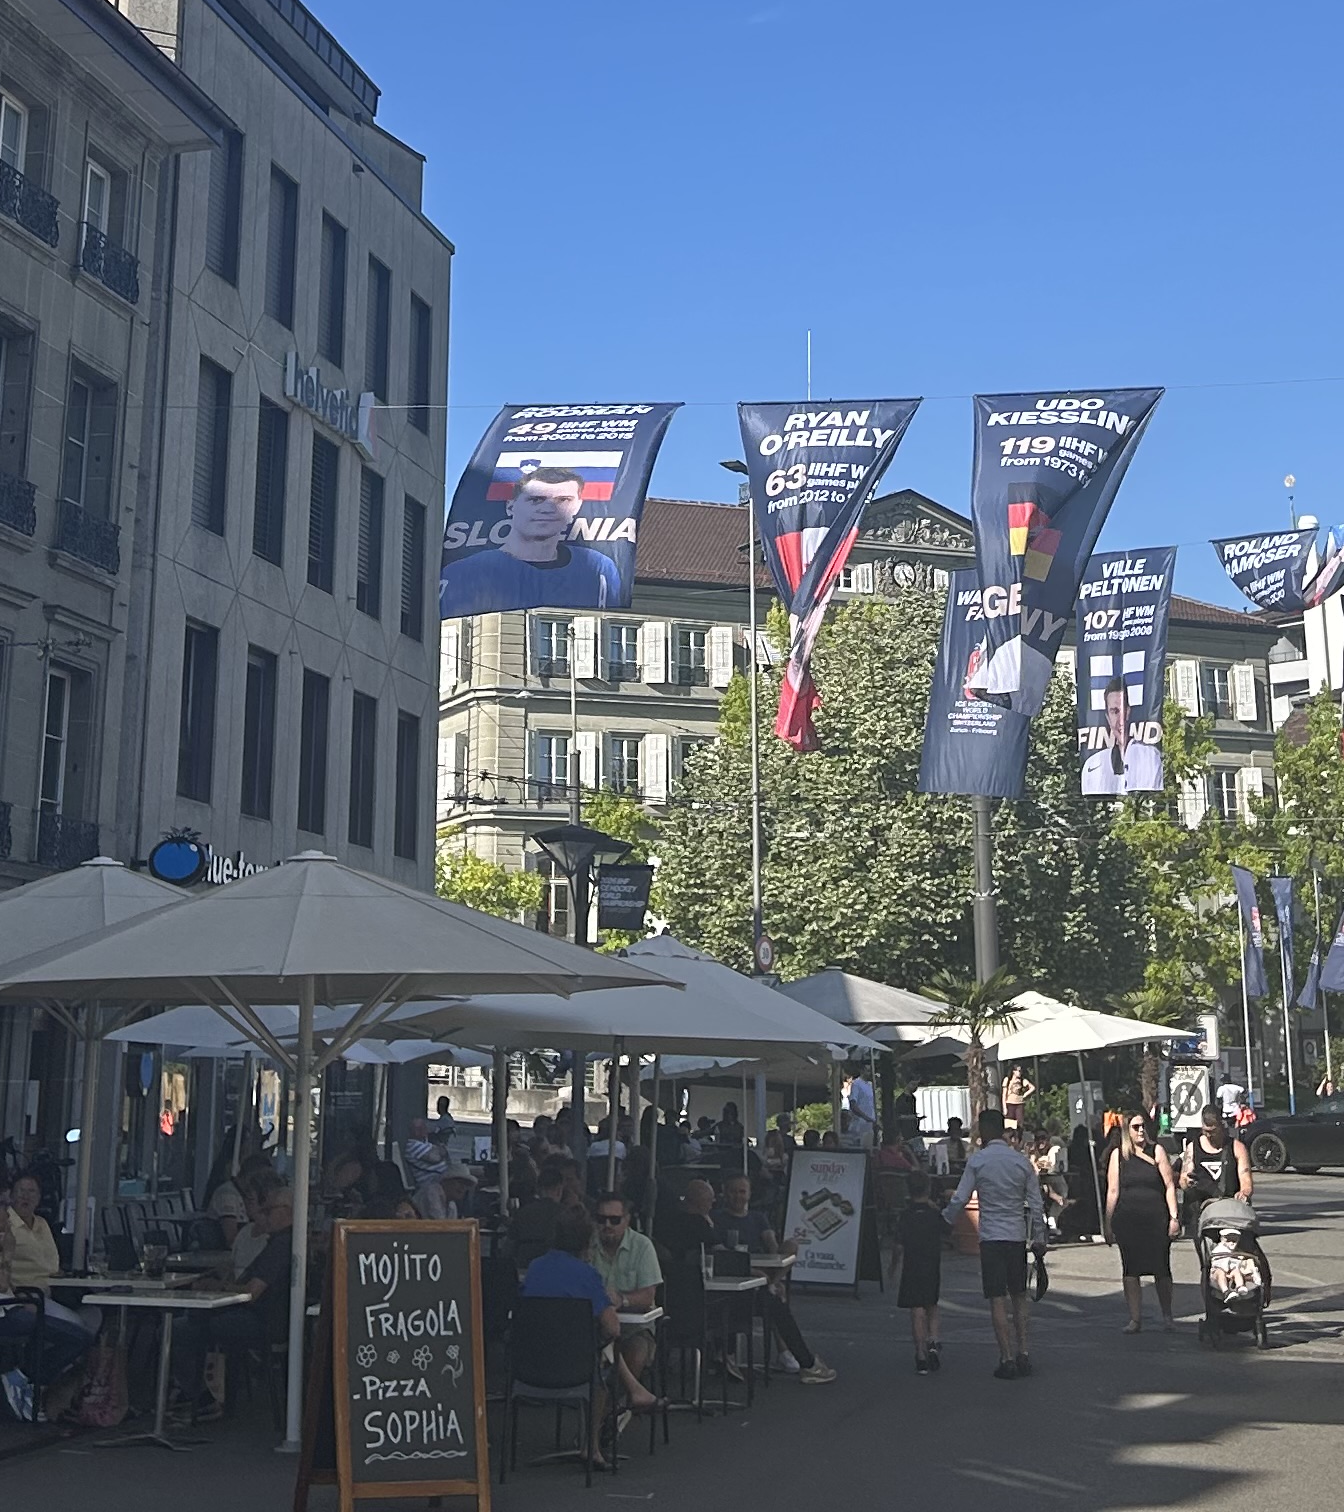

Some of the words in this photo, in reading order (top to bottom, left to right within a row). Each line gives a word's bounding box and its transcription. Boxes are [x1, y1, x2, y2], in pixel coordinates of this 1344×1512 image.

[1035, 398, 1105, 410] UDO
[508, 422, 558, 435] 49
[601, 419, 639, 428] WM
[784, 410, 871, 431] RYAN
[503, 435, 539, 443] from
[1000, 436, 1056, 455] 119
[1058, 435, 1098, 457] IIHF
[1000, 456, 1041, 467] from
[1043, 455, 1078, 478] 1973
[1058, 449, 1094, 470] games
[765, 463, 807, 497] 63
[807, 462, 850, 477] IIHF
[806, 478, 846, 489] games
[767, 494, 798, 514] from
[799, 489, 830, 504] 2012
[830, 490, 846, 503] to
[443, 518, 637, 550] SLONIA
[1223, 533, 1300, 561] ROLAND
[1102, 558, 1147, 579] VILLE
[1078, 574, 1165, 600] PELTONEN
[1083, 609, 1121, 631] 107
[1083, 631, 1107, 642] from
